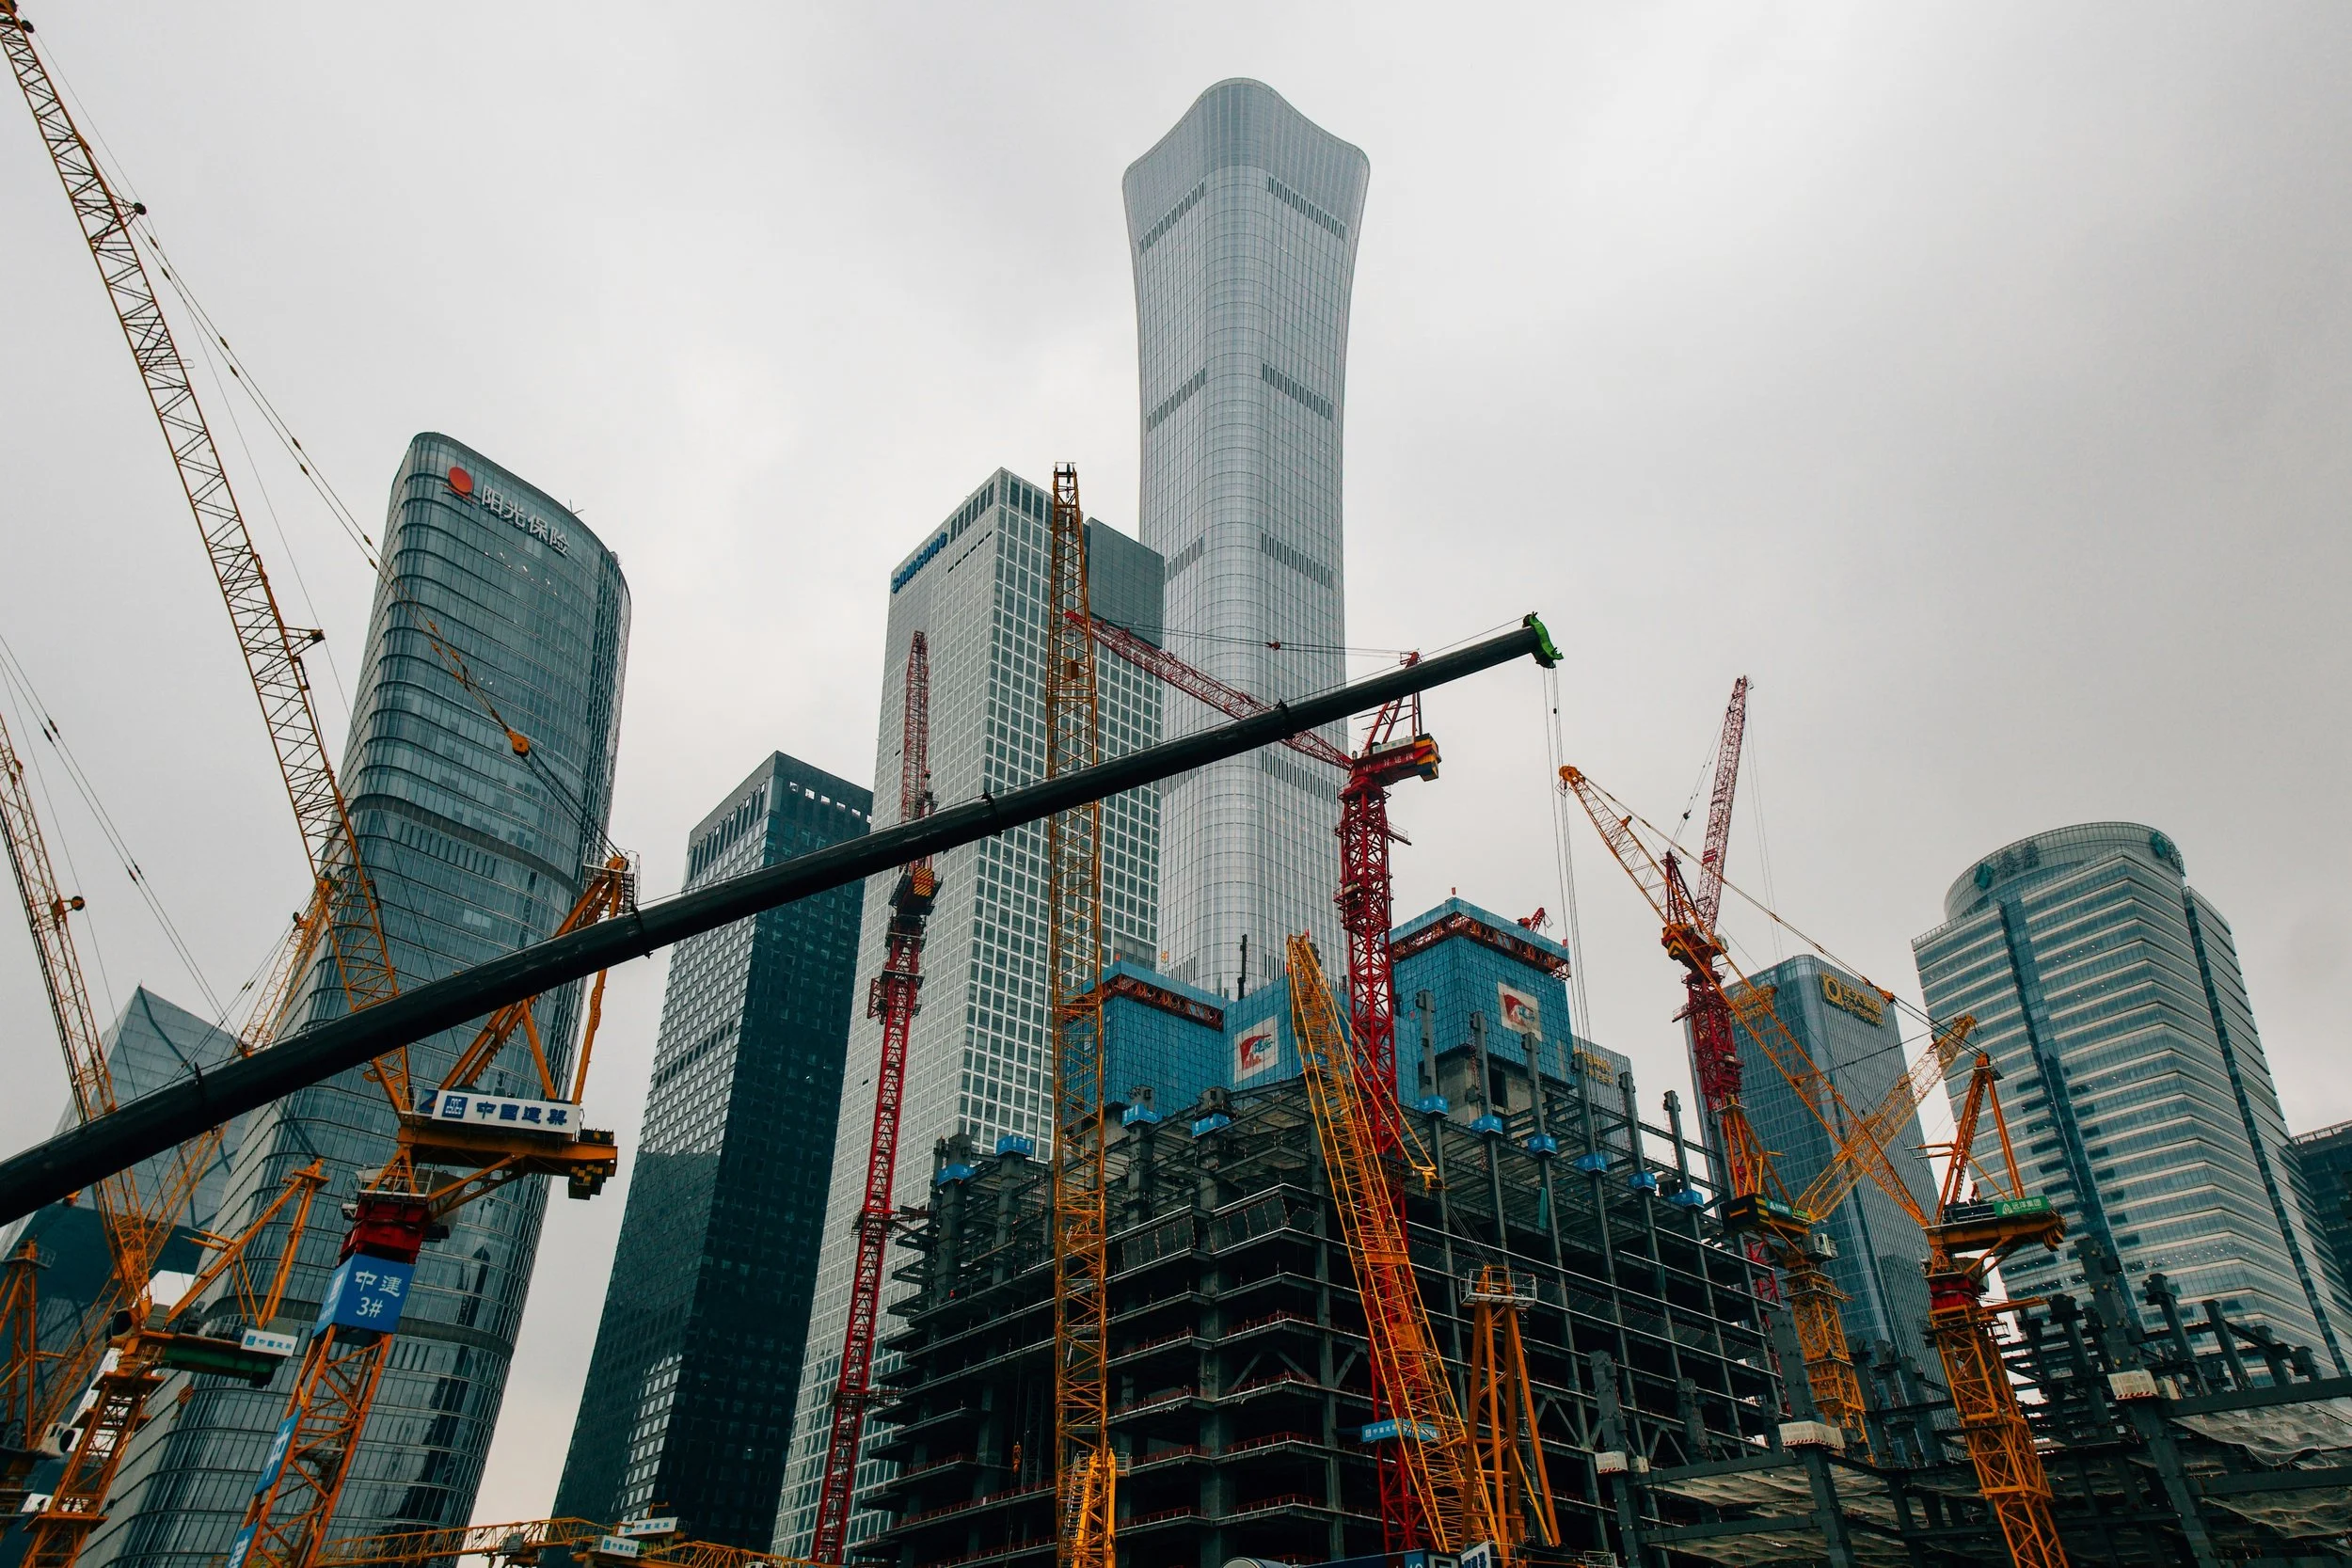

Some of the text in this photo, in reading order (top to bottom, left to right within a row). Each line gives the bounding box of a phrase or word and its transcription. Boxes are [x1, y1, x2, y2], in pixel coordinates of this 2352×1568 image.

[481, 484, 570, 558] 阳光保险
[891, 531, 948, 594] SAMSUNG
[355, 1270, 403, 1298] 中建
[356, 1297, 384, 1319] 3#
